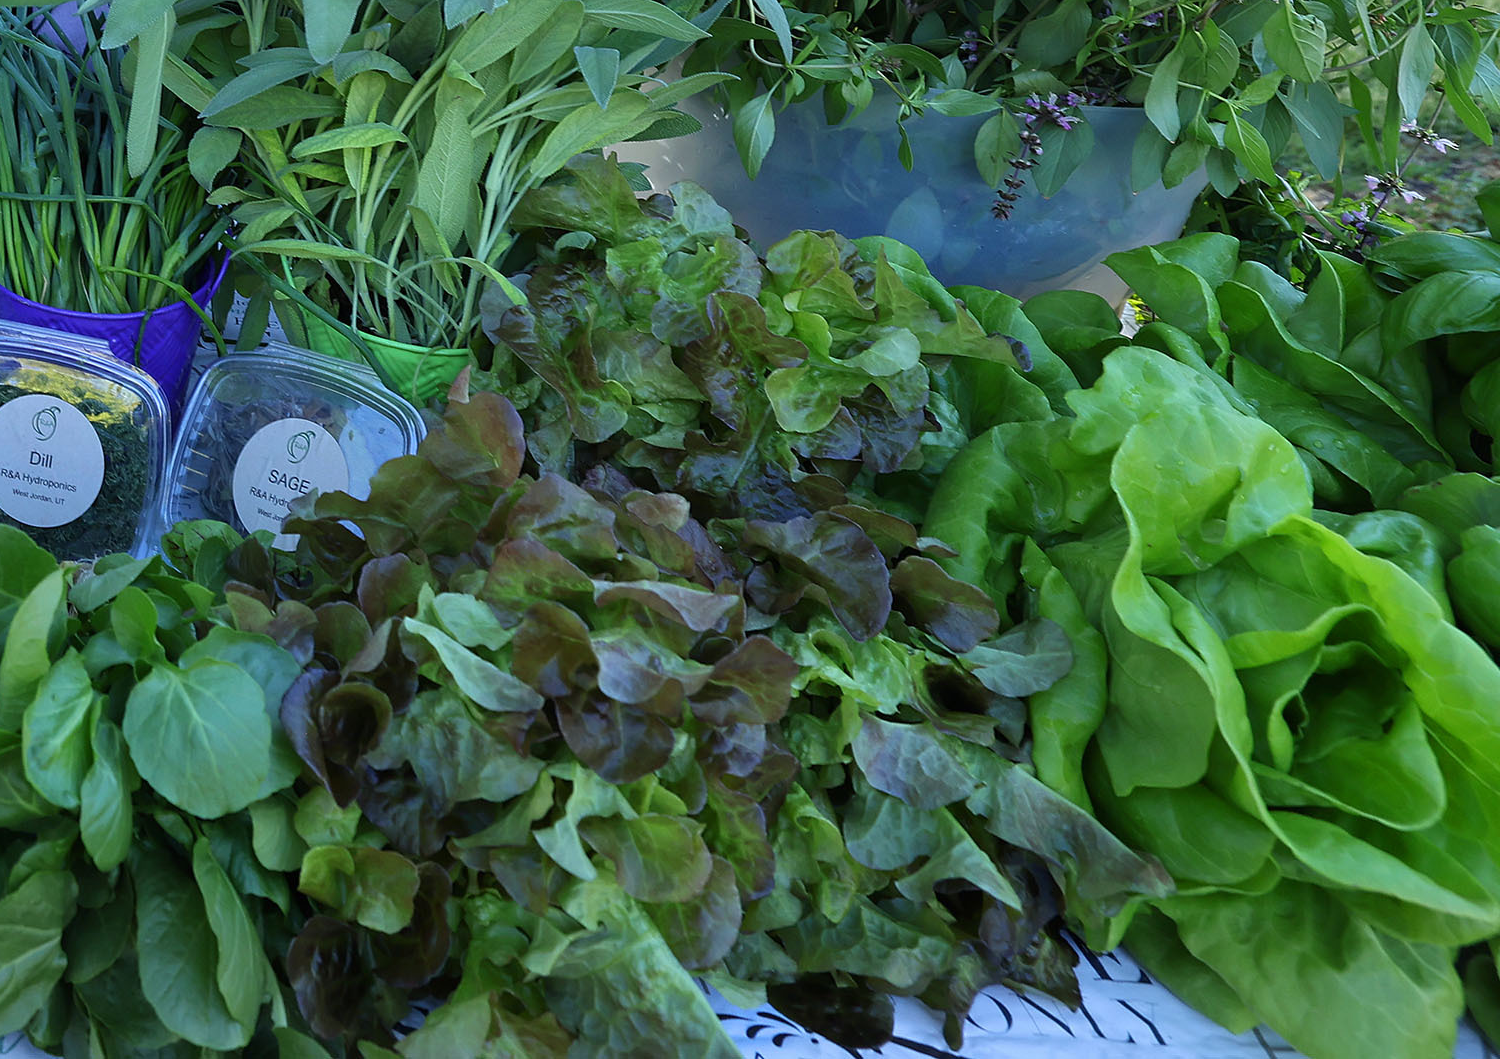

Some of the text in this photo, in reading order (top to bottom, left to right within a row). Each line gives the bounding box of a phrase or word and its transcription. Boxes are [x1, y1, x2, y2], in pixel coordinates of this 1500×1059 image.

[29, 451, 53, 469] Dill
[0, 468, 77, 493] R&A Hydroponics
[268, 469, 311, 495] SAGE
[12, 488, 66, 506] West Jordan, UT
[249, 486, 268, 501] R&A
[257, 508, 272, 519] West
